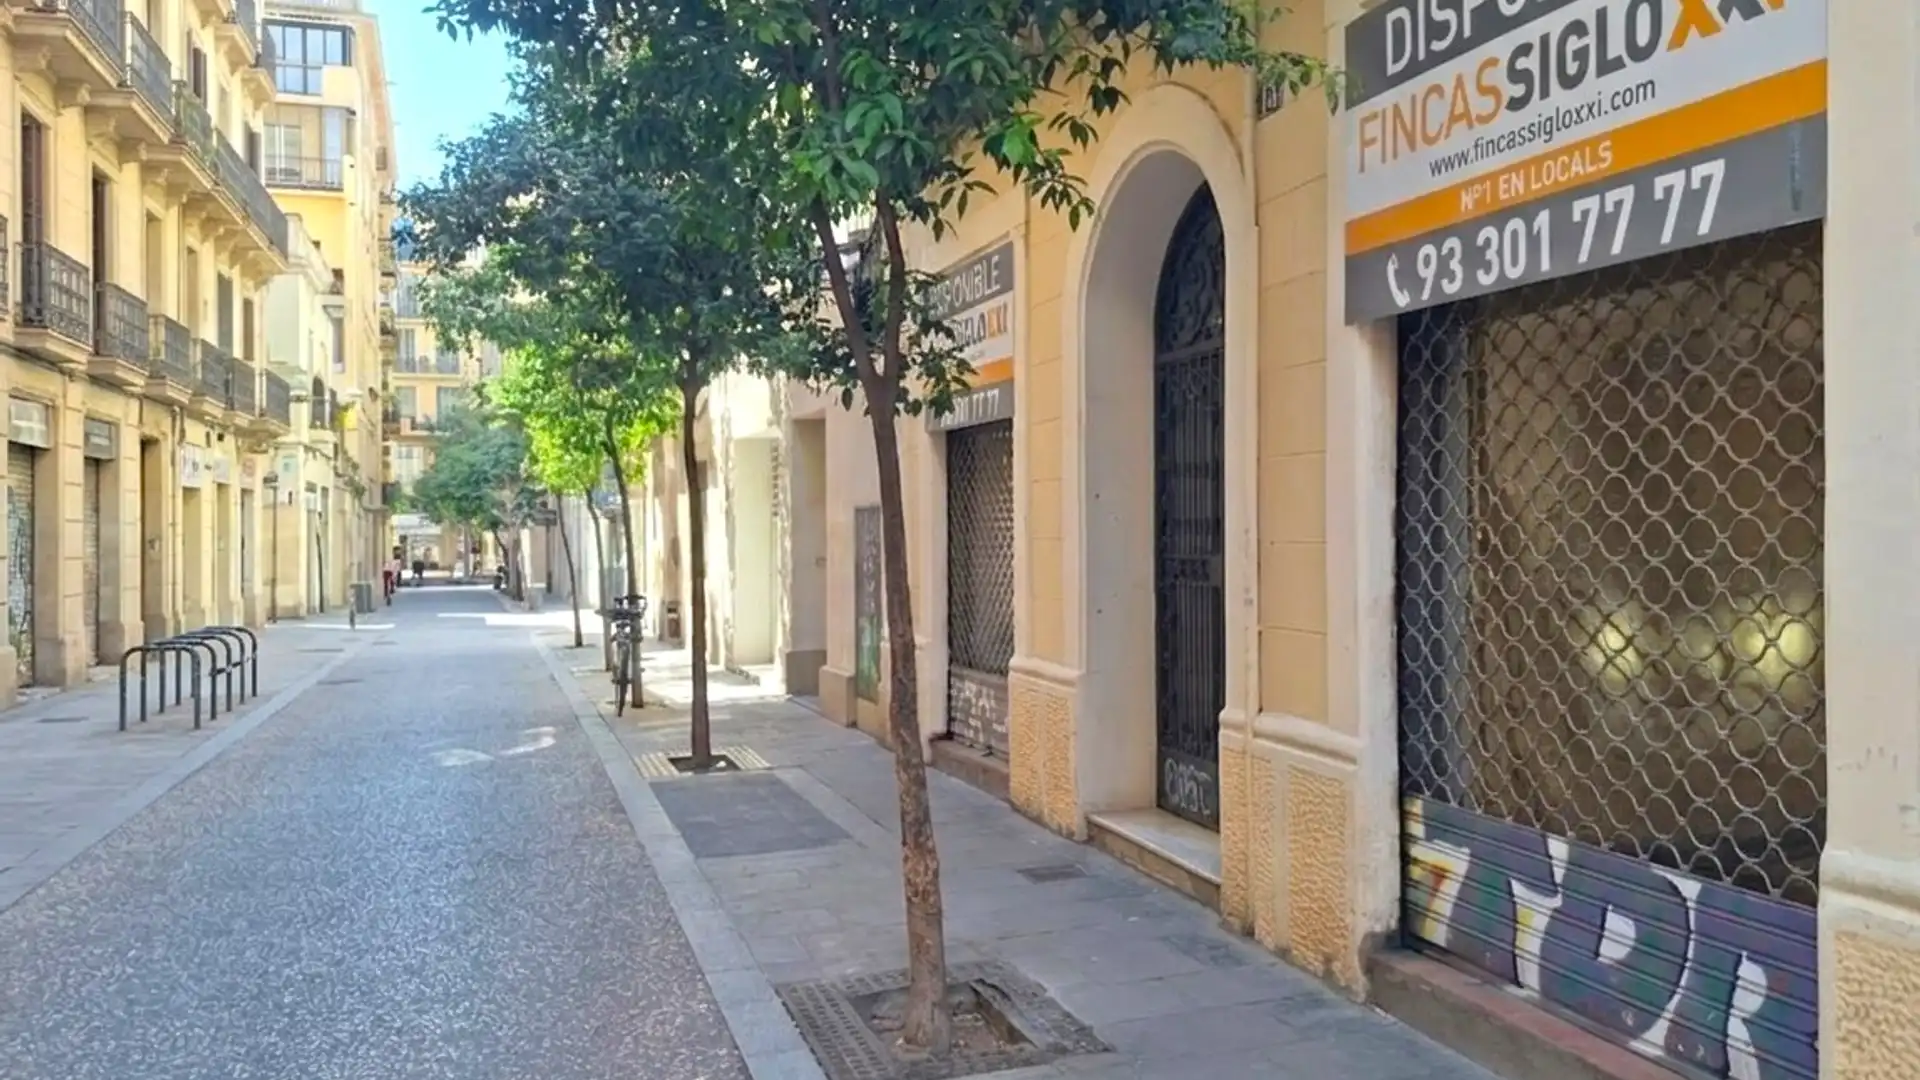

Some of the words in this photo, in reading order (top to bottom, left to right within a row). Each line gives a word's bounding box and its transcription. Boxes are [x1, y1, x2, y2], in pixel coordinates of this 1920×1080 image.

[1429, 80, 1656, 177] www.fincassigloxxi.com
[1499, 171, 1525, 200] EN
[1531, 140, 1613, 189] LOCALS
[1417, 237, 1463, 300] 93
[1476, 208, 1550, 286] 301
[1572, 184, 1635, 263] 77
[1654, 159, 1726, 245] 77
